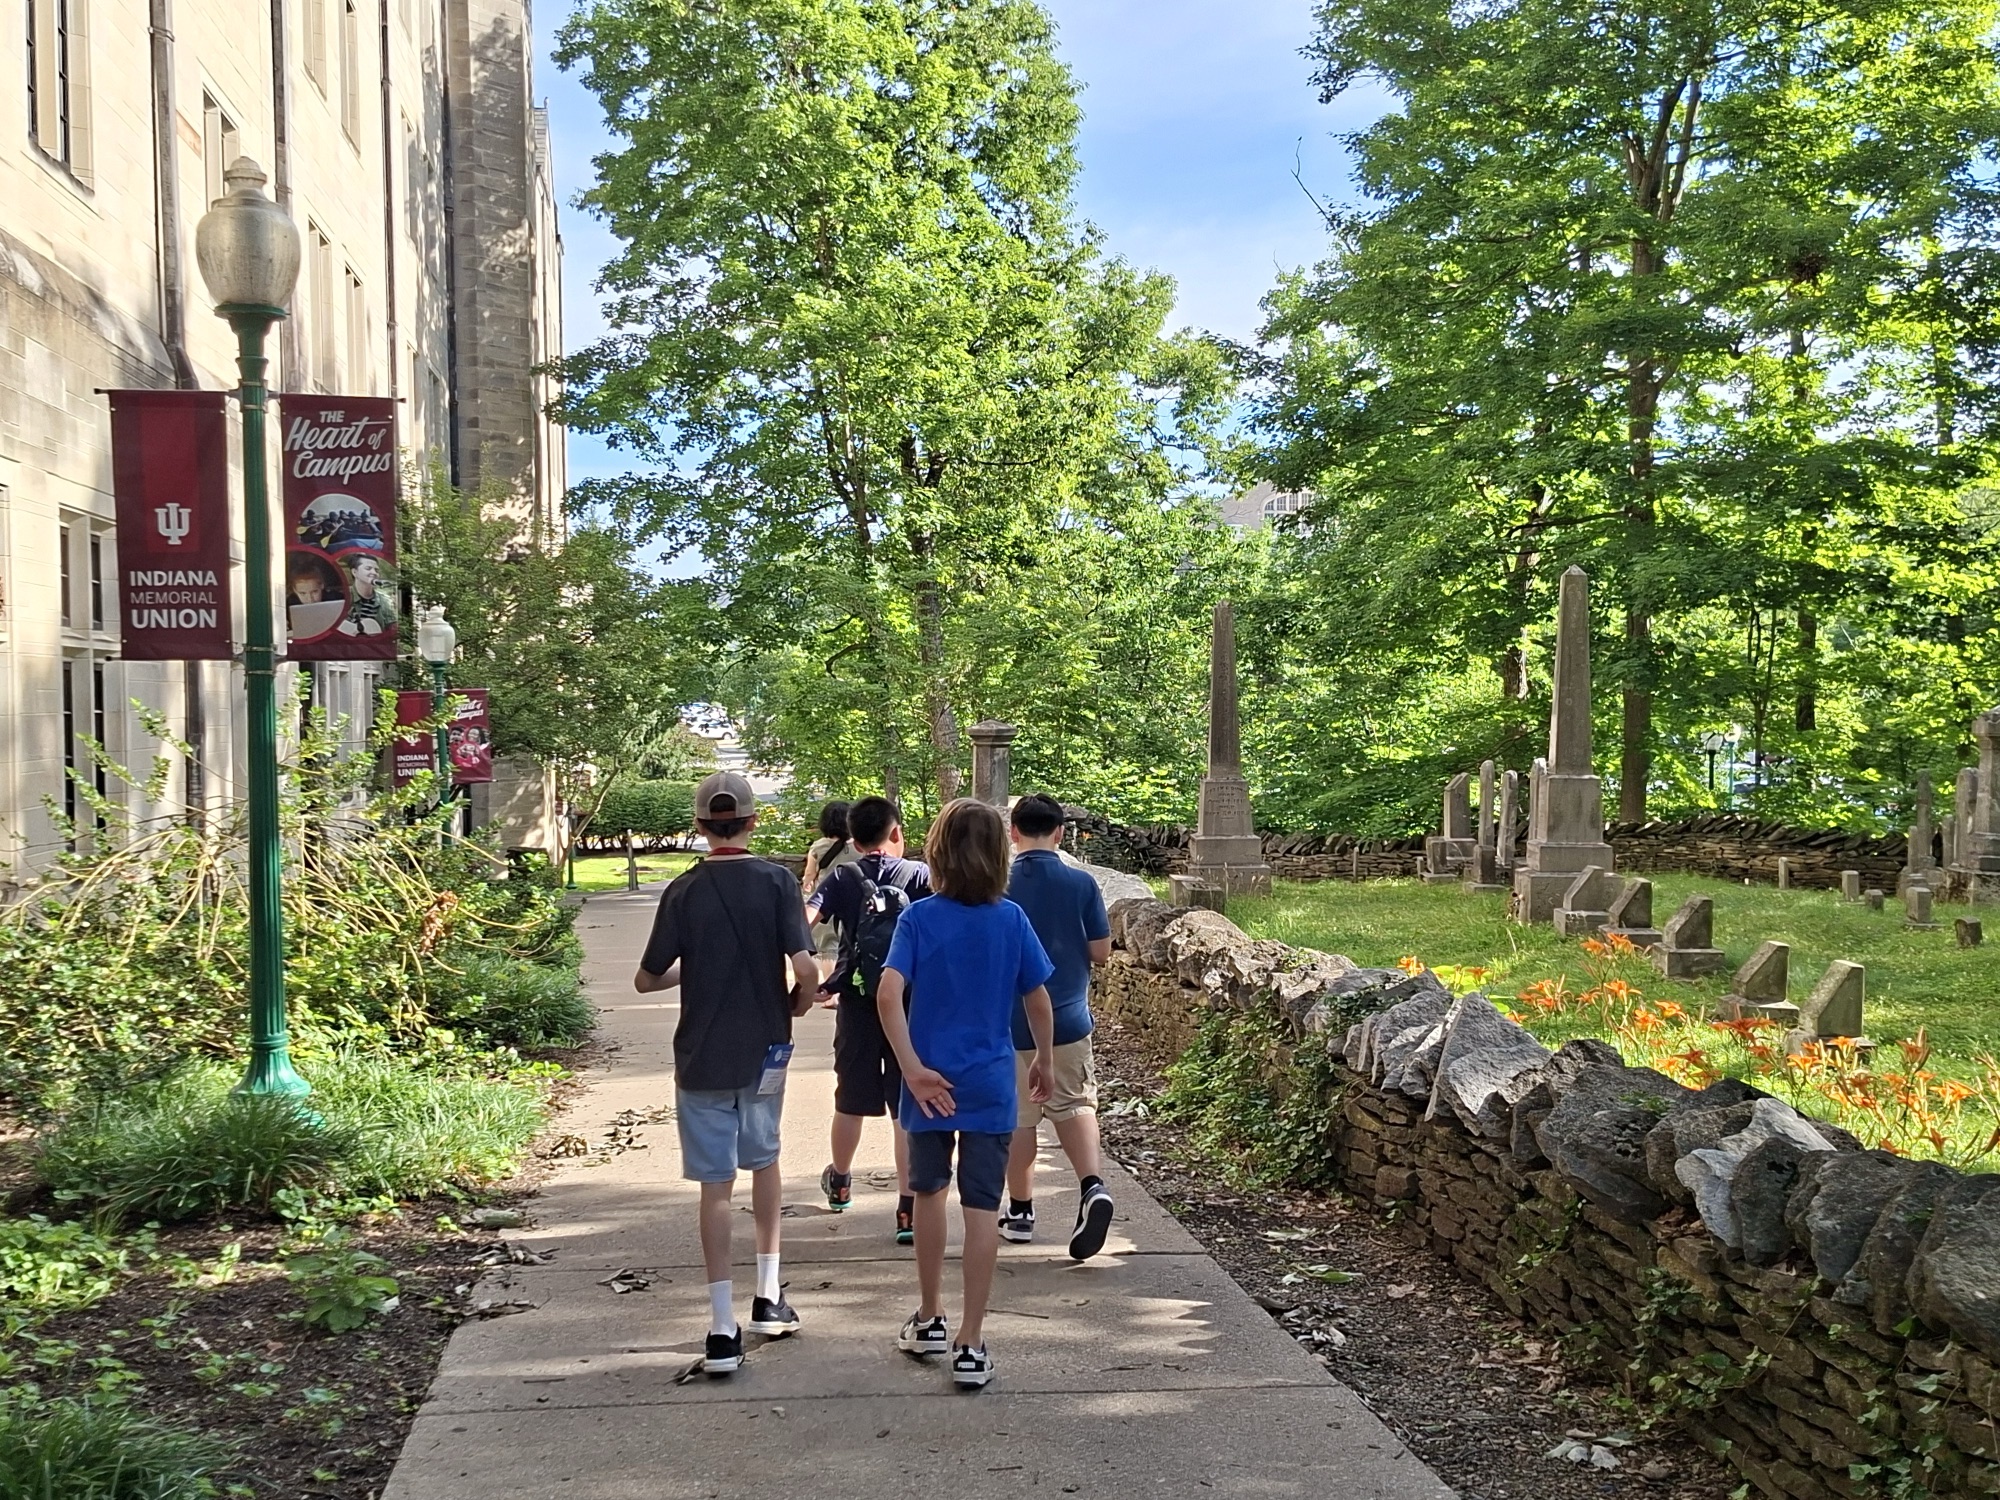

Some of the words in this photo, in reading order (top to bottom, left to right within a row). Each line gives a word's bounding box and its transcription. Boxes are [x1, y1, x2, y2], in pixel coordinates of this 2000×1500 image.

[319, 410, 345, 424] THE
[284, 416, 392, 452] Heart
[367, 429, 385, 450] of
[293, 451, 392, 485] Campus
[130, 571, 218, 587] INDIANA
[131, 591, 217, 605] MEMORIAL
[131, 608, 217, 629] UNION
